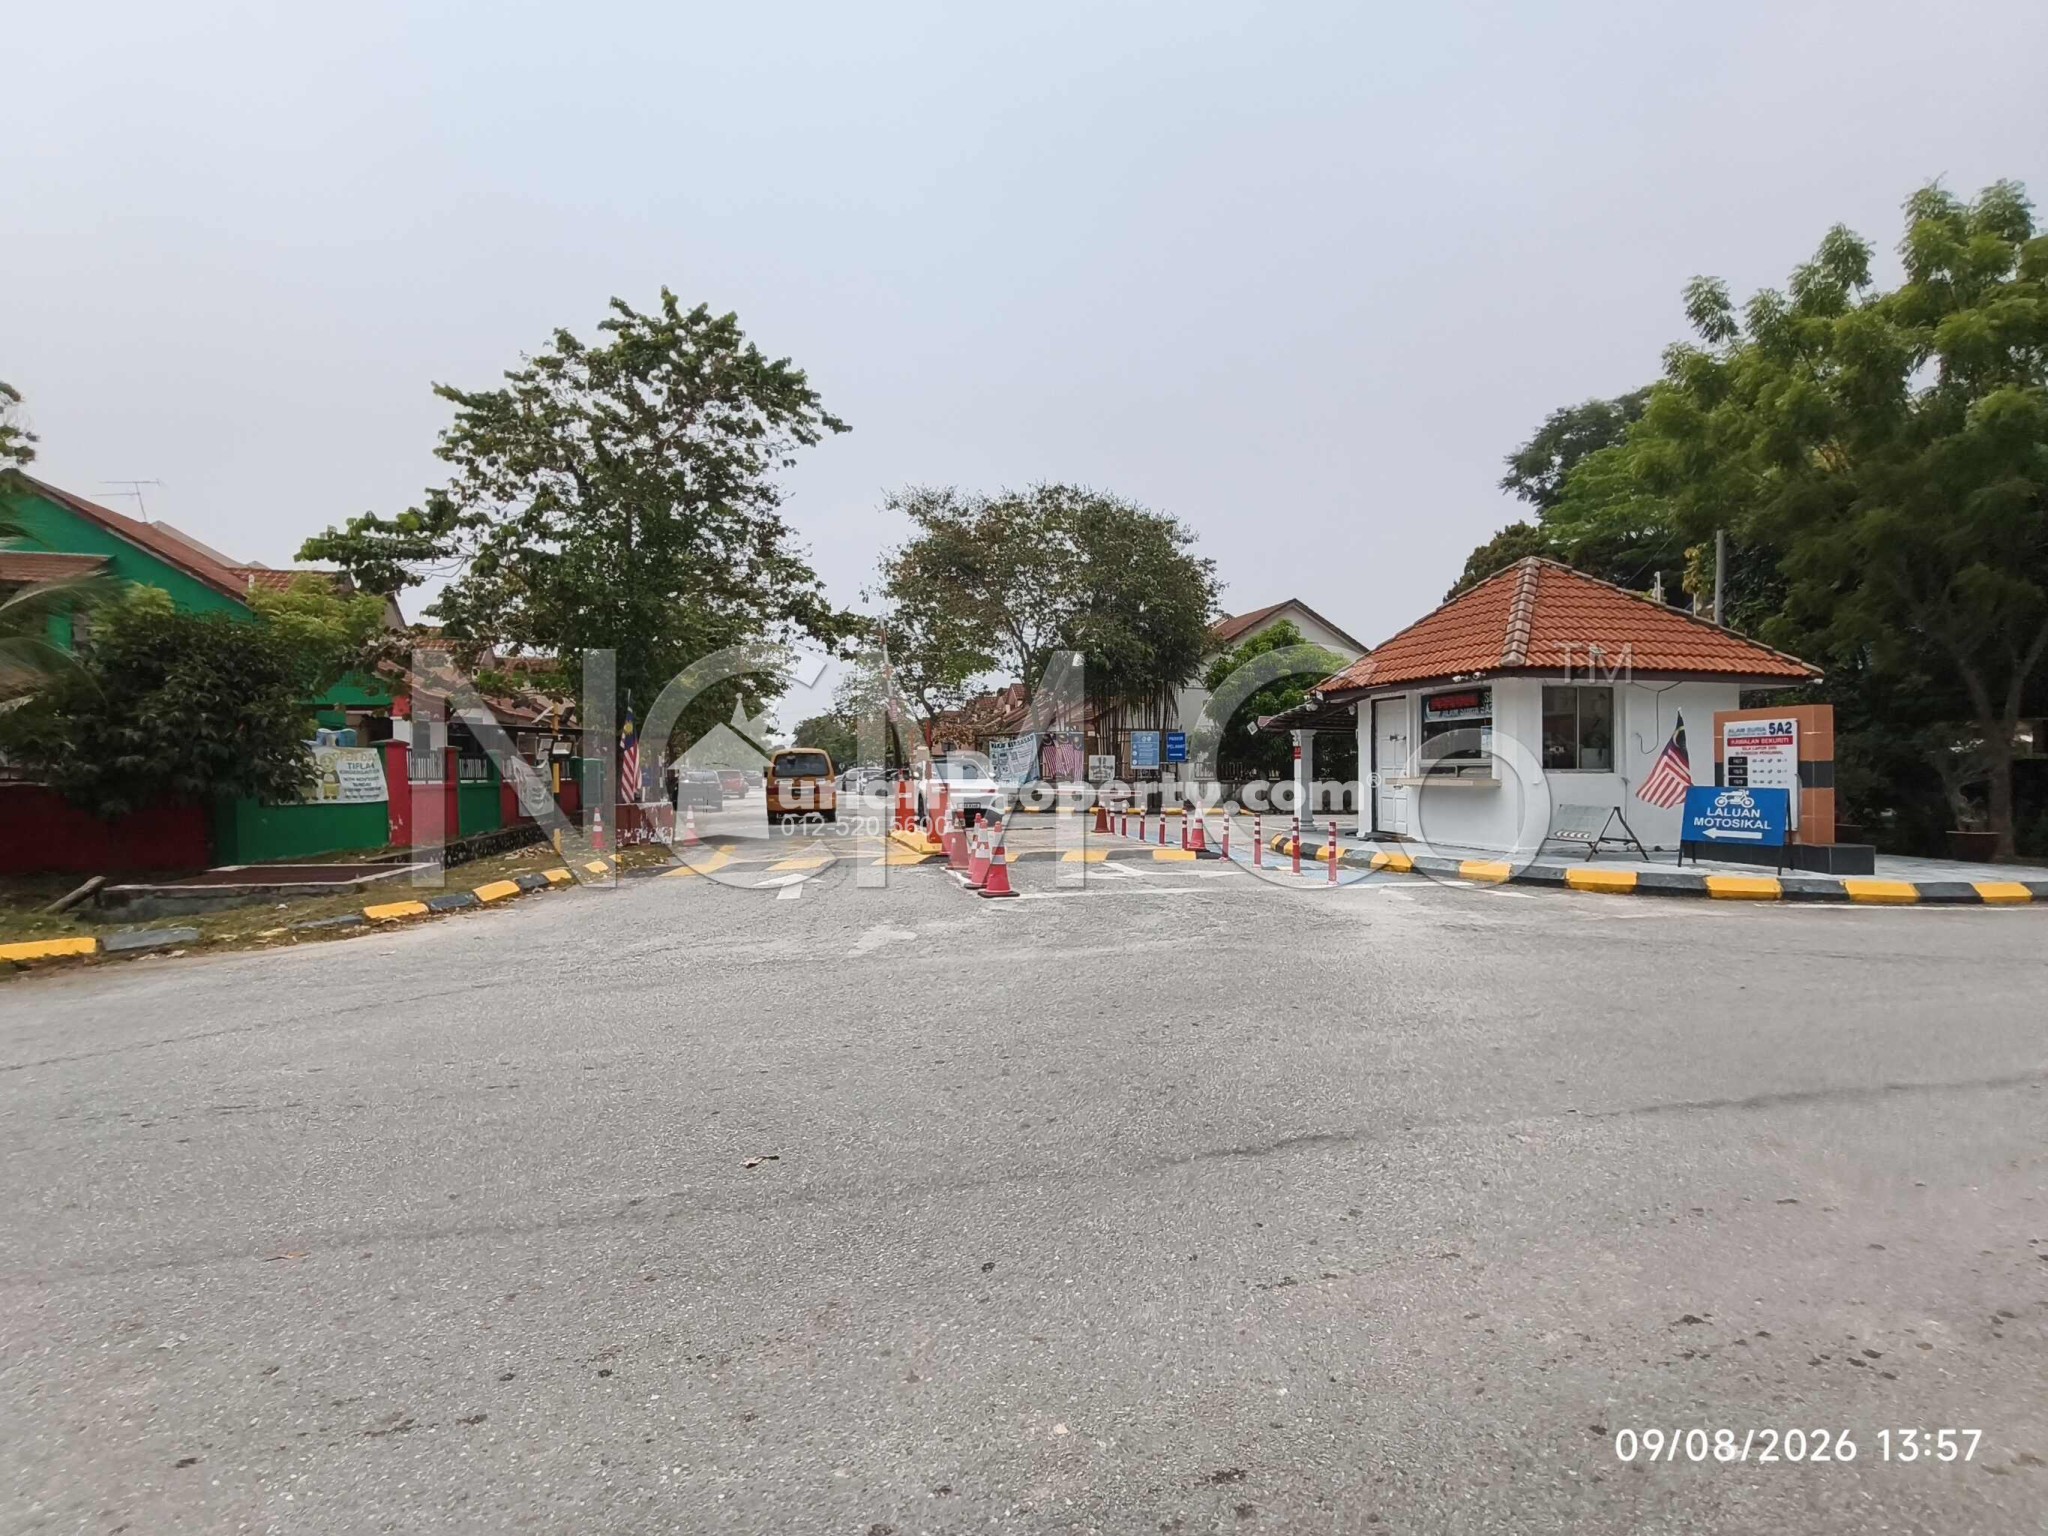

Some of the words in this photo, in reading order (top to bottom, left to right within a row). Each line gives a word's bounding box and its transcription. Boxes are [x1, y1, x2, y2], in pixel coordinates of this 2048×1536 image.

[1768, 721, 1793, 735] 5A2
[1706, 807, 1760, 817] LALUAN
[1693, 817, 1772, 829] MOTOSIKAL
